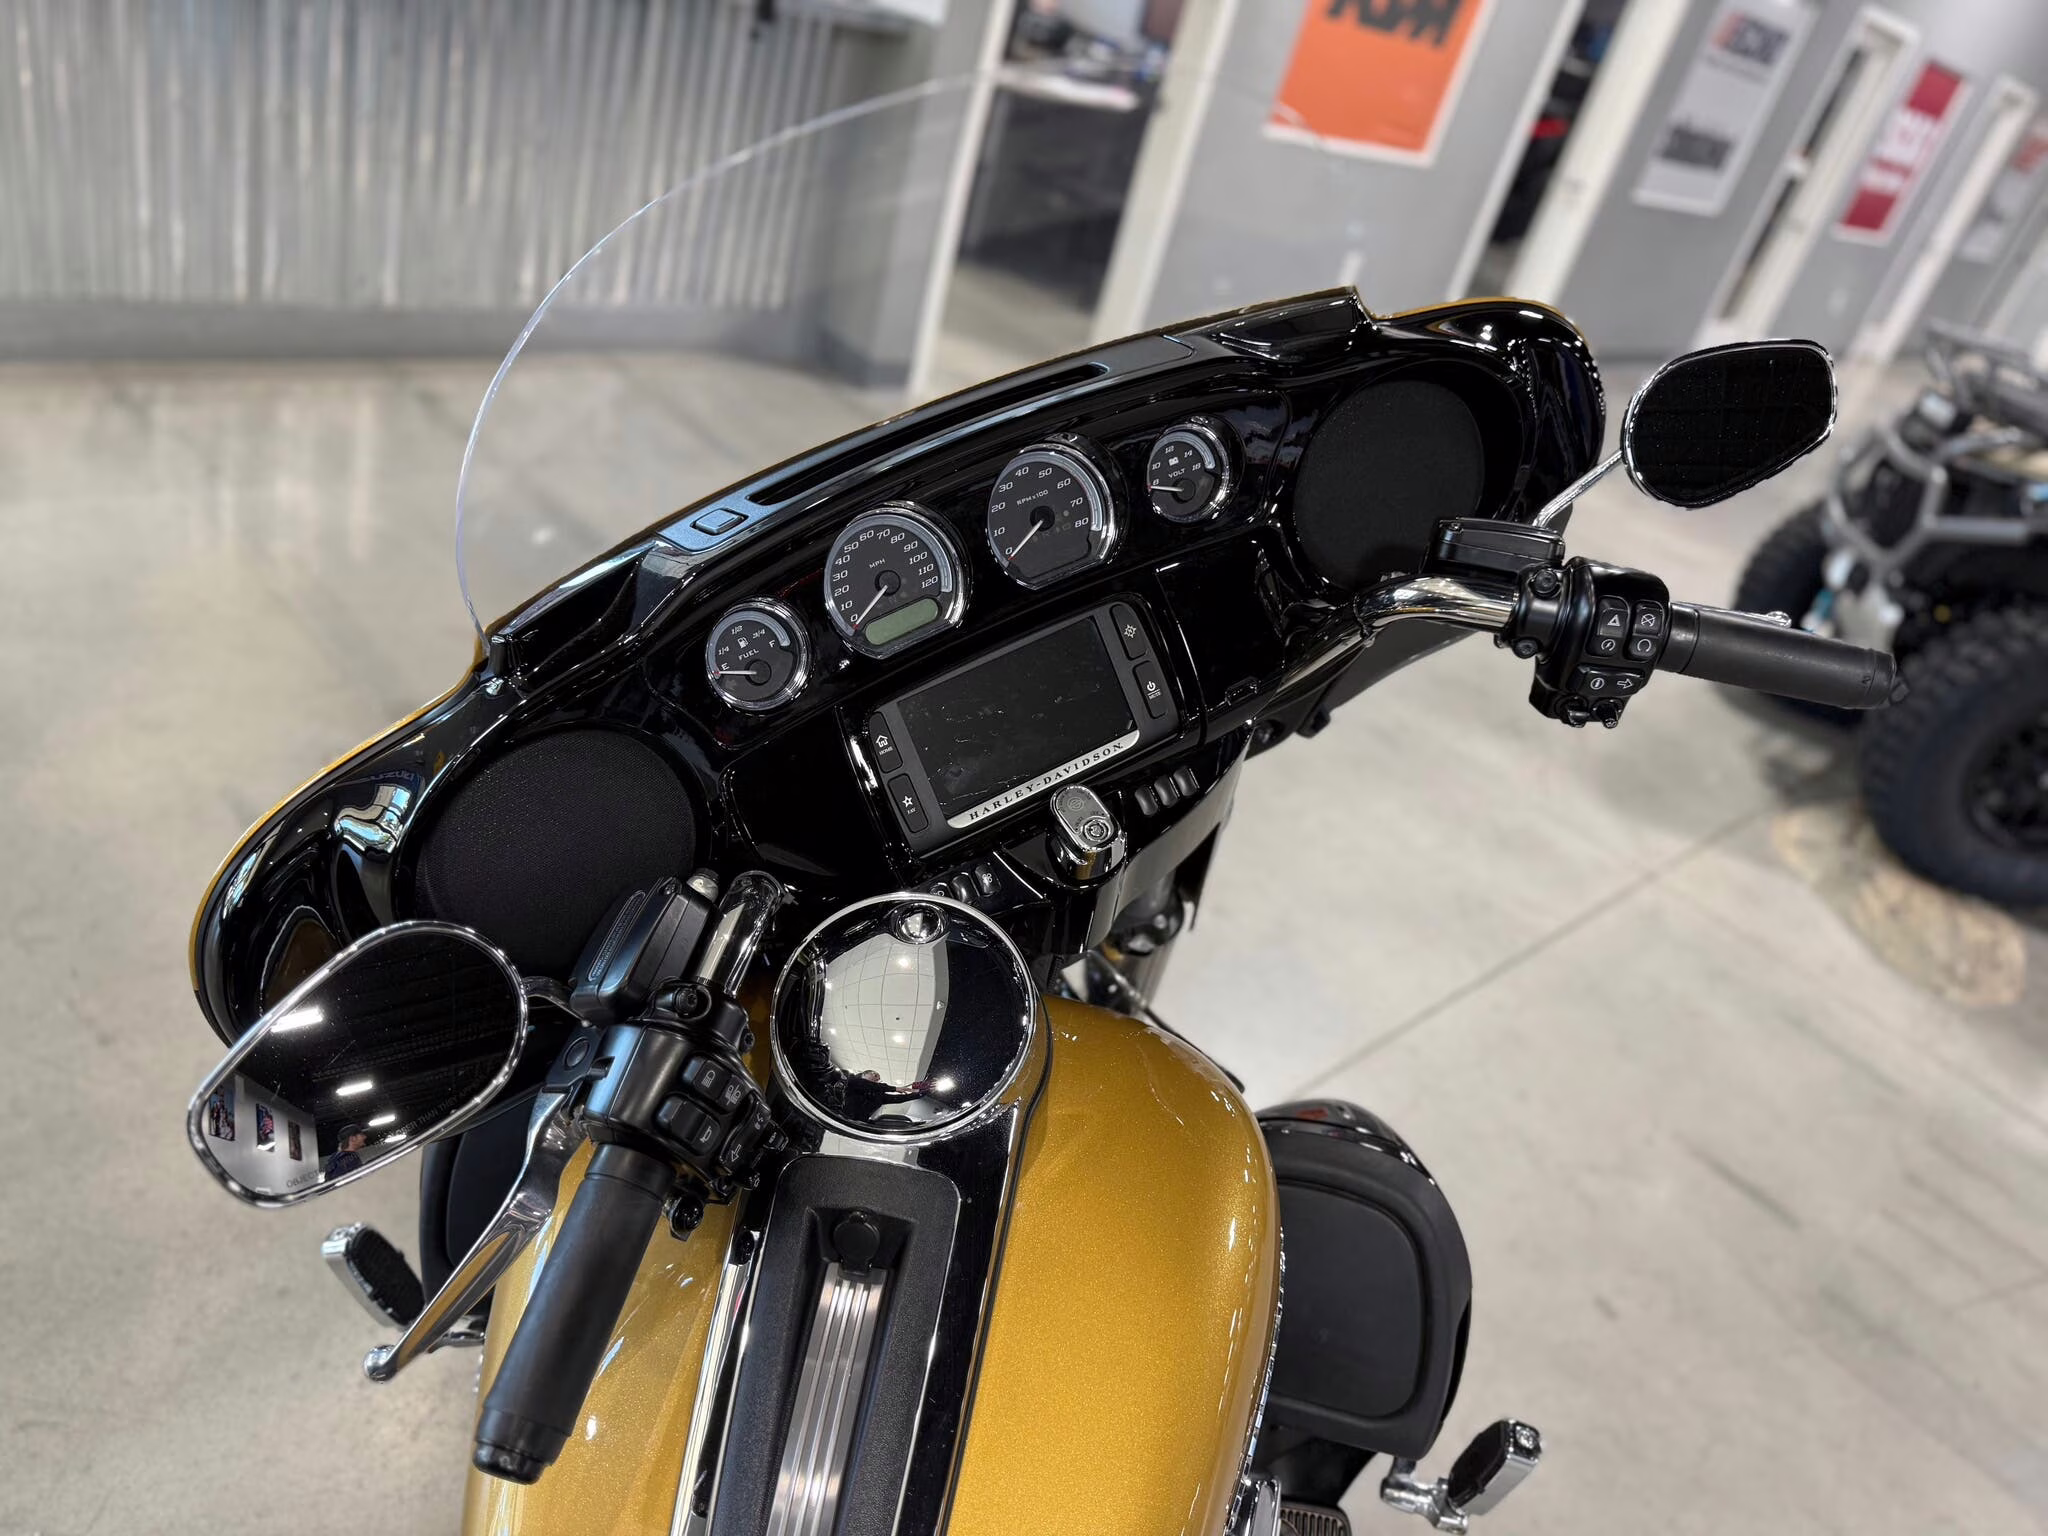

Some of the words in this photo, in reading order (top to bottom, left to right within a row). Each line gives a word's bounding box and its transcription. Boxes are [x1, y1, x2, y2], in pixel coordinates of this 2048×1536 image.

[1015, 466, 1029, 477] 40
[1038, 467, 1052, 478] 50
[999, 481, 1013, 493] 30
[1057, 477, 1071, 489] 60
[991, 502, 1006, 513] 20
[1070, 497, 1083, 508] 70
[1074, 517, 1088, 528] 80
[859, 529, 874, 541] 60
[876, 528, 890, 540] 70
[993, 526, 1005, 537] 10
[890, 532, 905, 544] 80
[843, 541, 859, 553] 50
[903, 540, 918, 553] 90
[1005, 546, 1012, 555] 0
[835, 554, 850, 566] 40
[869, 558, 885, 569] MPH
[909, 551, 928, 565] 100
[918, 563, 934, 576] 110
[832, 570, 848, 582] 30
[921, 575, 938, 589] 120
[834, 585, 849, 597] 20
[840, 600, 853, 611] 10
[850, 613, 858, 622] 0
[768, 639, 775, 648] F
[718, 646, 730, 656] 1/4
[738, 648, 760, 660] FUEL
[721, 662, 730, 671] E
[969, 742, 1124, 821] HARLEY-DAVIDSON
